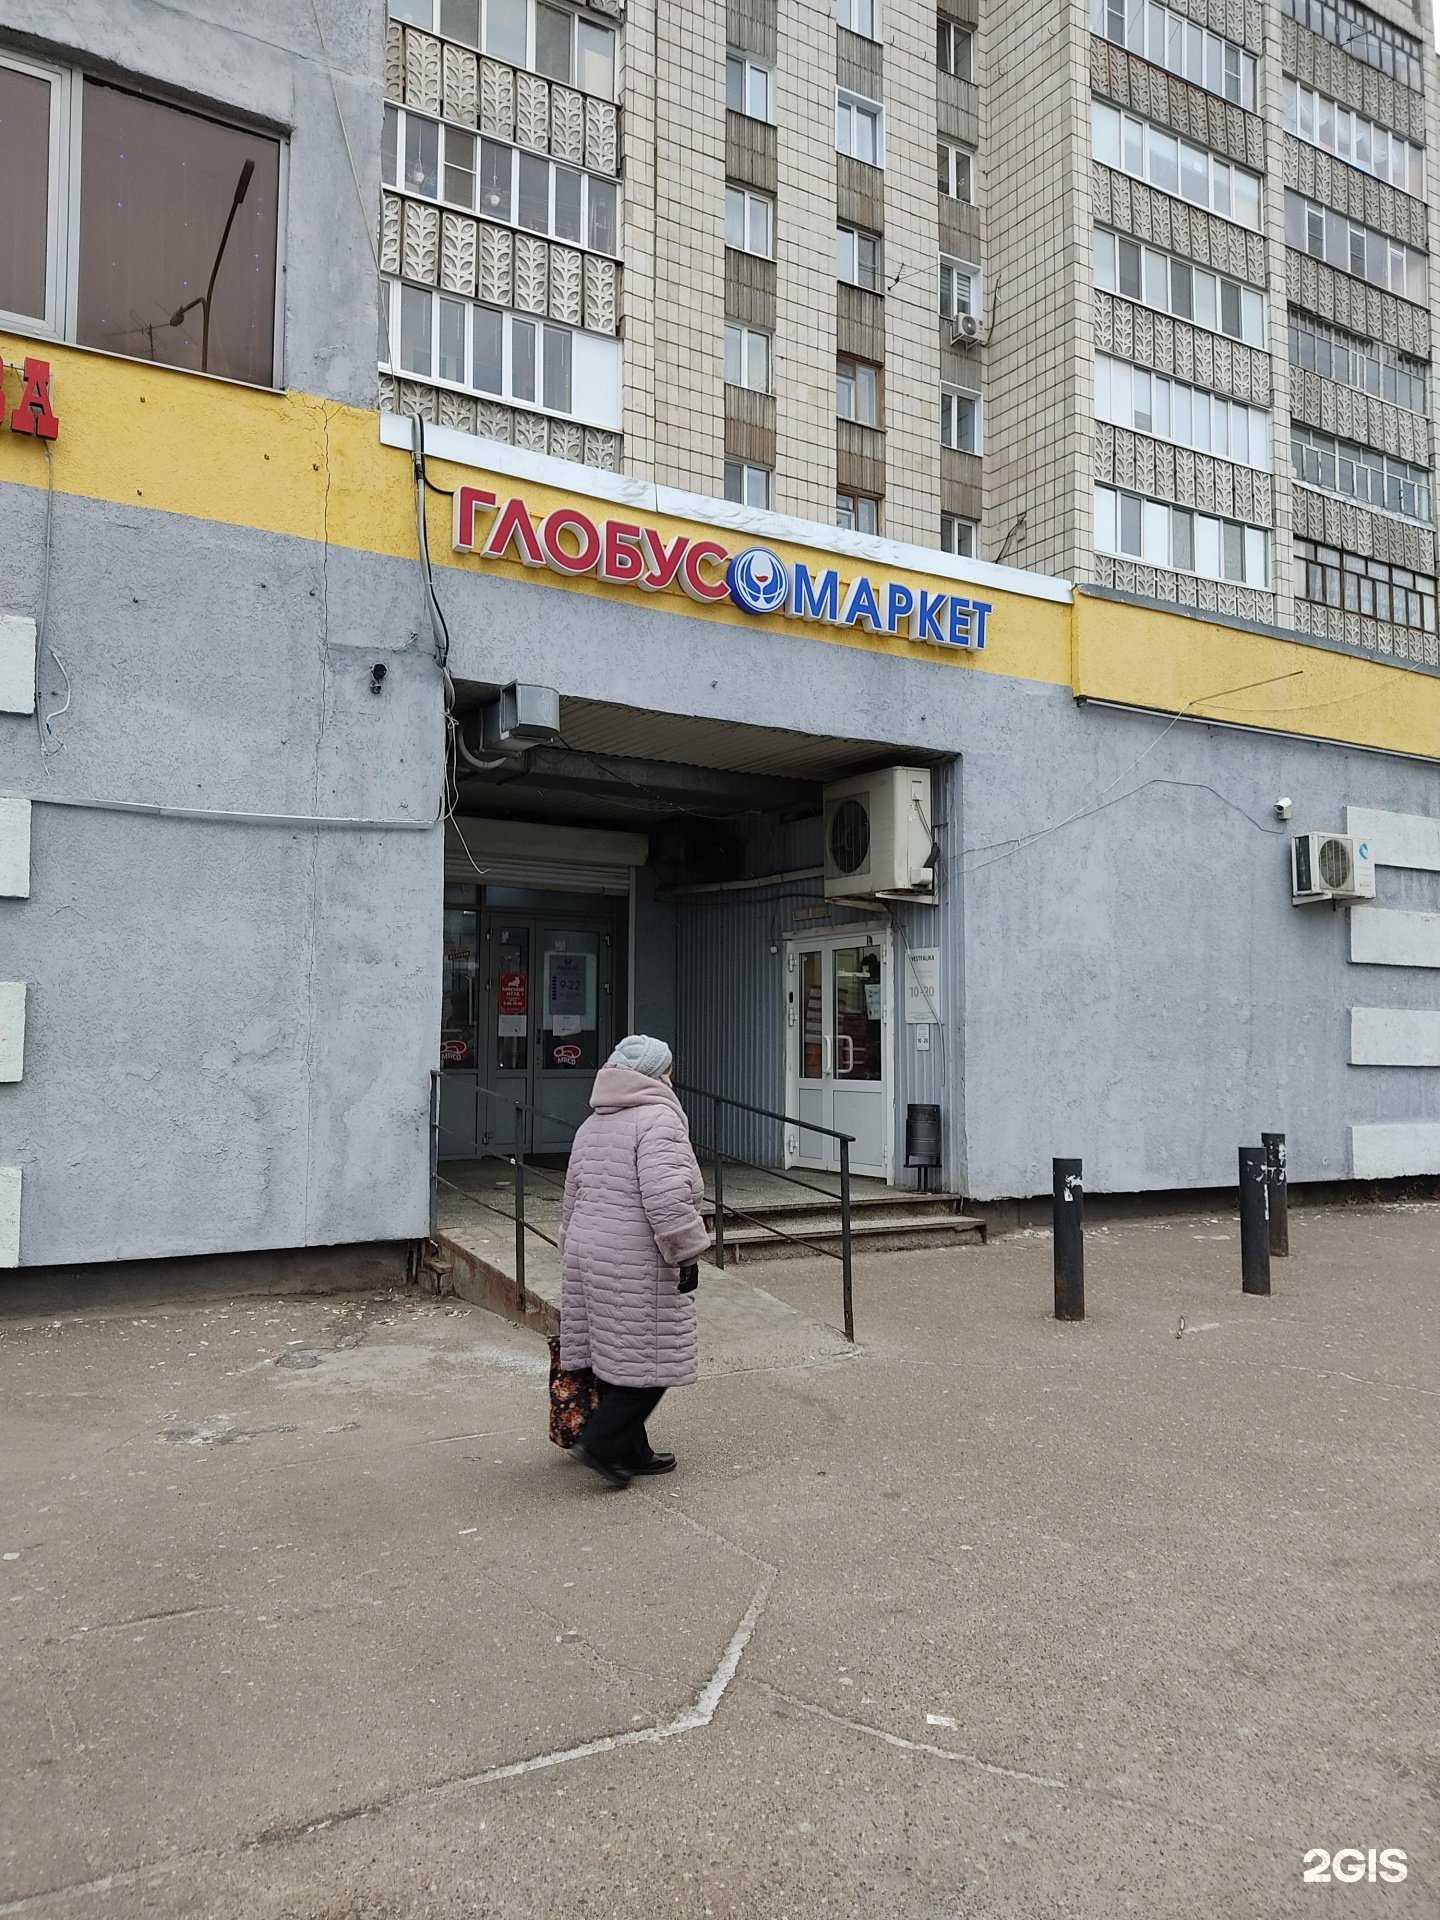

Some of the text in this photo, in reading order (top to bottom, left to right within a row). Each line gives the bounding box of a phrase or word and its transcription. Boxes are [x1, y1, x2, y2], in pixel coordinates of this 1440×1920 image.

[0, 354, 59, 441] А
[453, 485, 992, 650] ГЛОБУС МАРКЕТ
